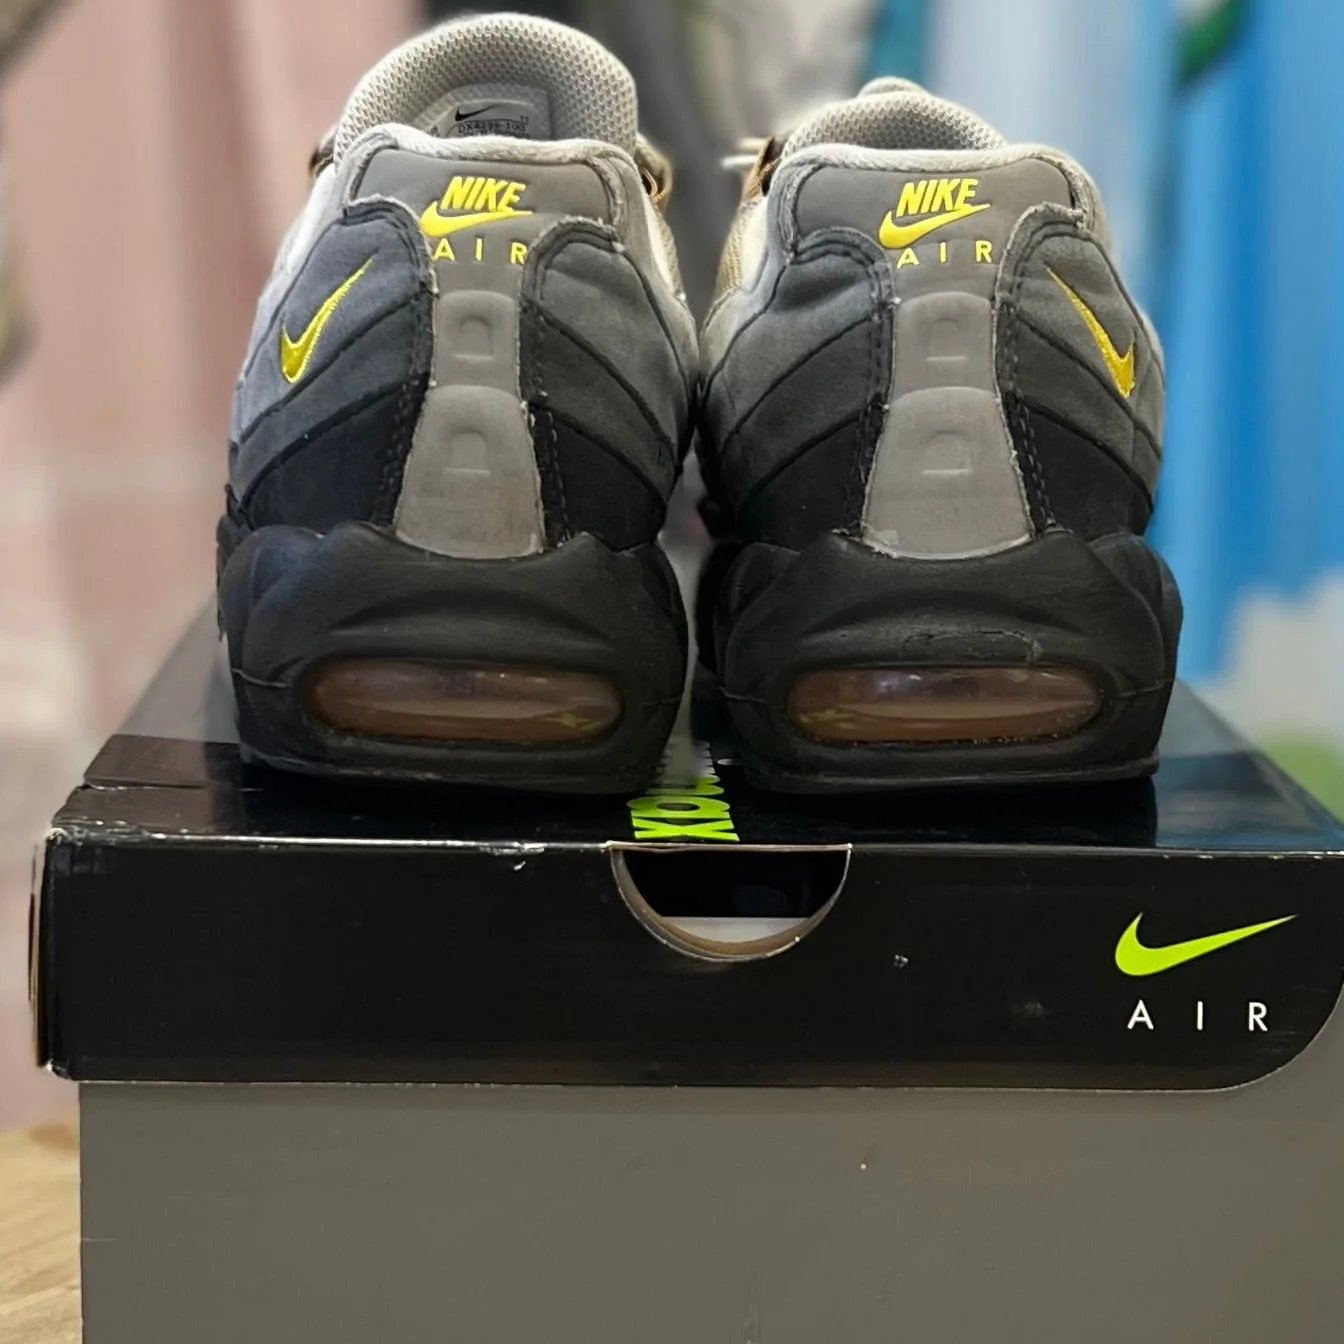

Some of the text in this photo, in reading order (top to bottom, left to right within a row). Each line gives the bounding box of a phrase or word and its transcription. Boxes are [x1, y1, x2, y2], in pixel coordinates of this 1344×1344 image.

[440, 176, 526, 212] NIKE
[896, 178, 978, 218] NIKE
[432, 238, 528, 264] AIR
[896, 240, 994, 269] AIR
[1127, 999, 1268, 1031] AIR
